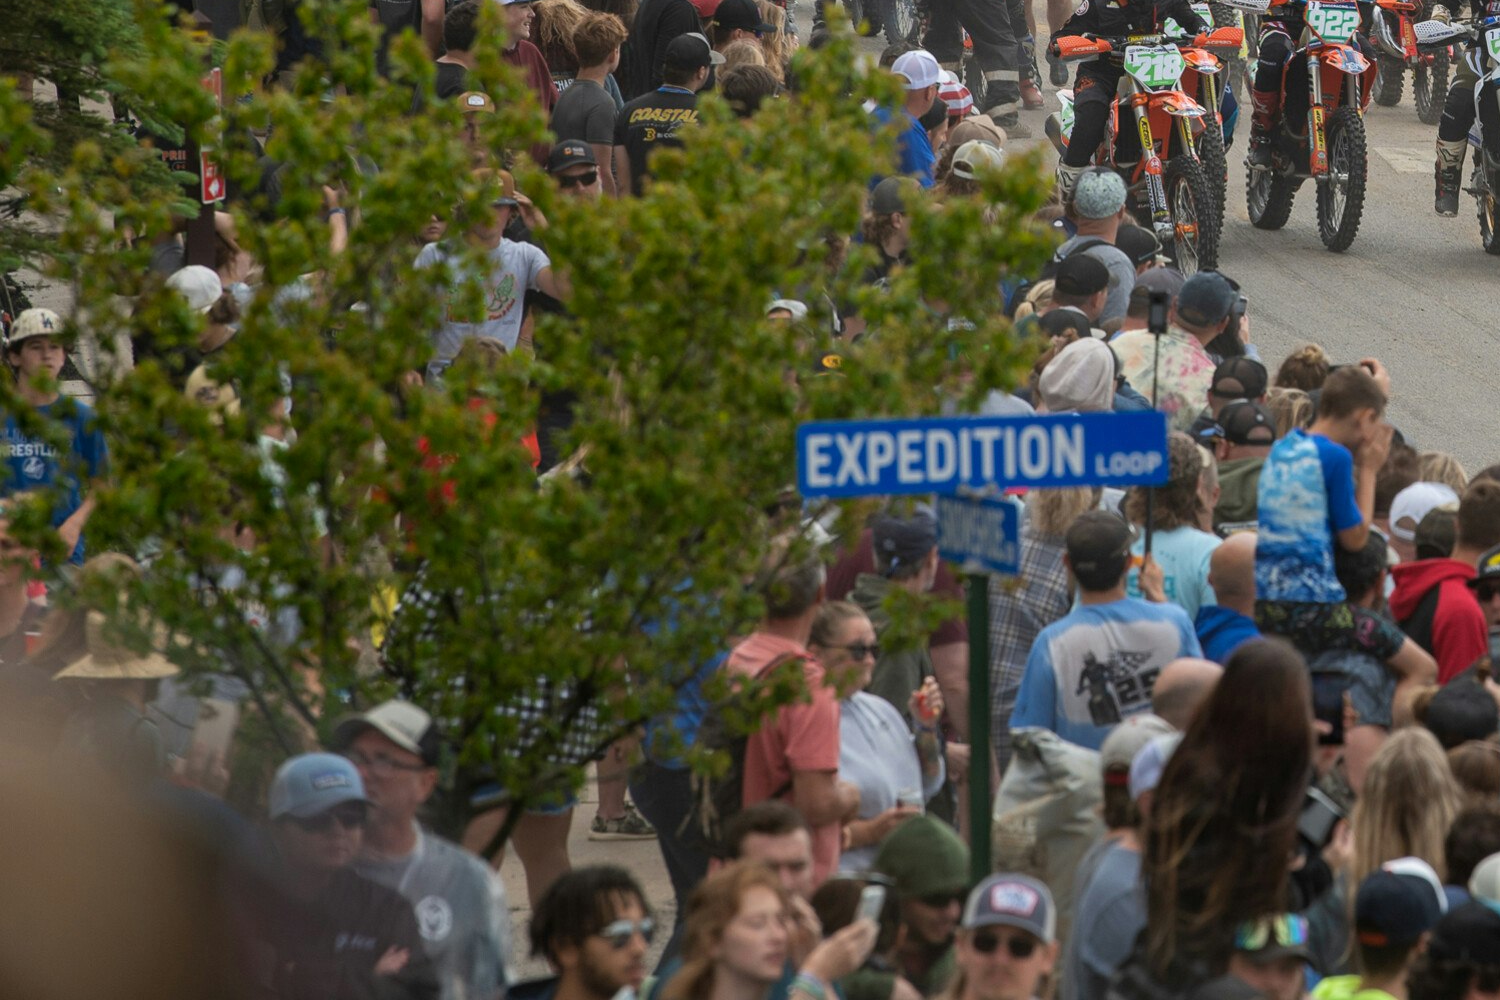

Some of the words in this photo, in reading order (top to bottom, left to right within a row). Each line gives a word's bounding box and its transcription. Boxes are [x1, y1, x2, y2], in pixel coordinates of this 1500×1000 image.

[1308, 9, 1360, 39] 922
[1134, 53, 1182, 82] 218
[628, 107, 699, 123] COASTAL
[806, 424, 1085, 488] EXPEDITION
[1095, 451, 1163, 476] LOOP
